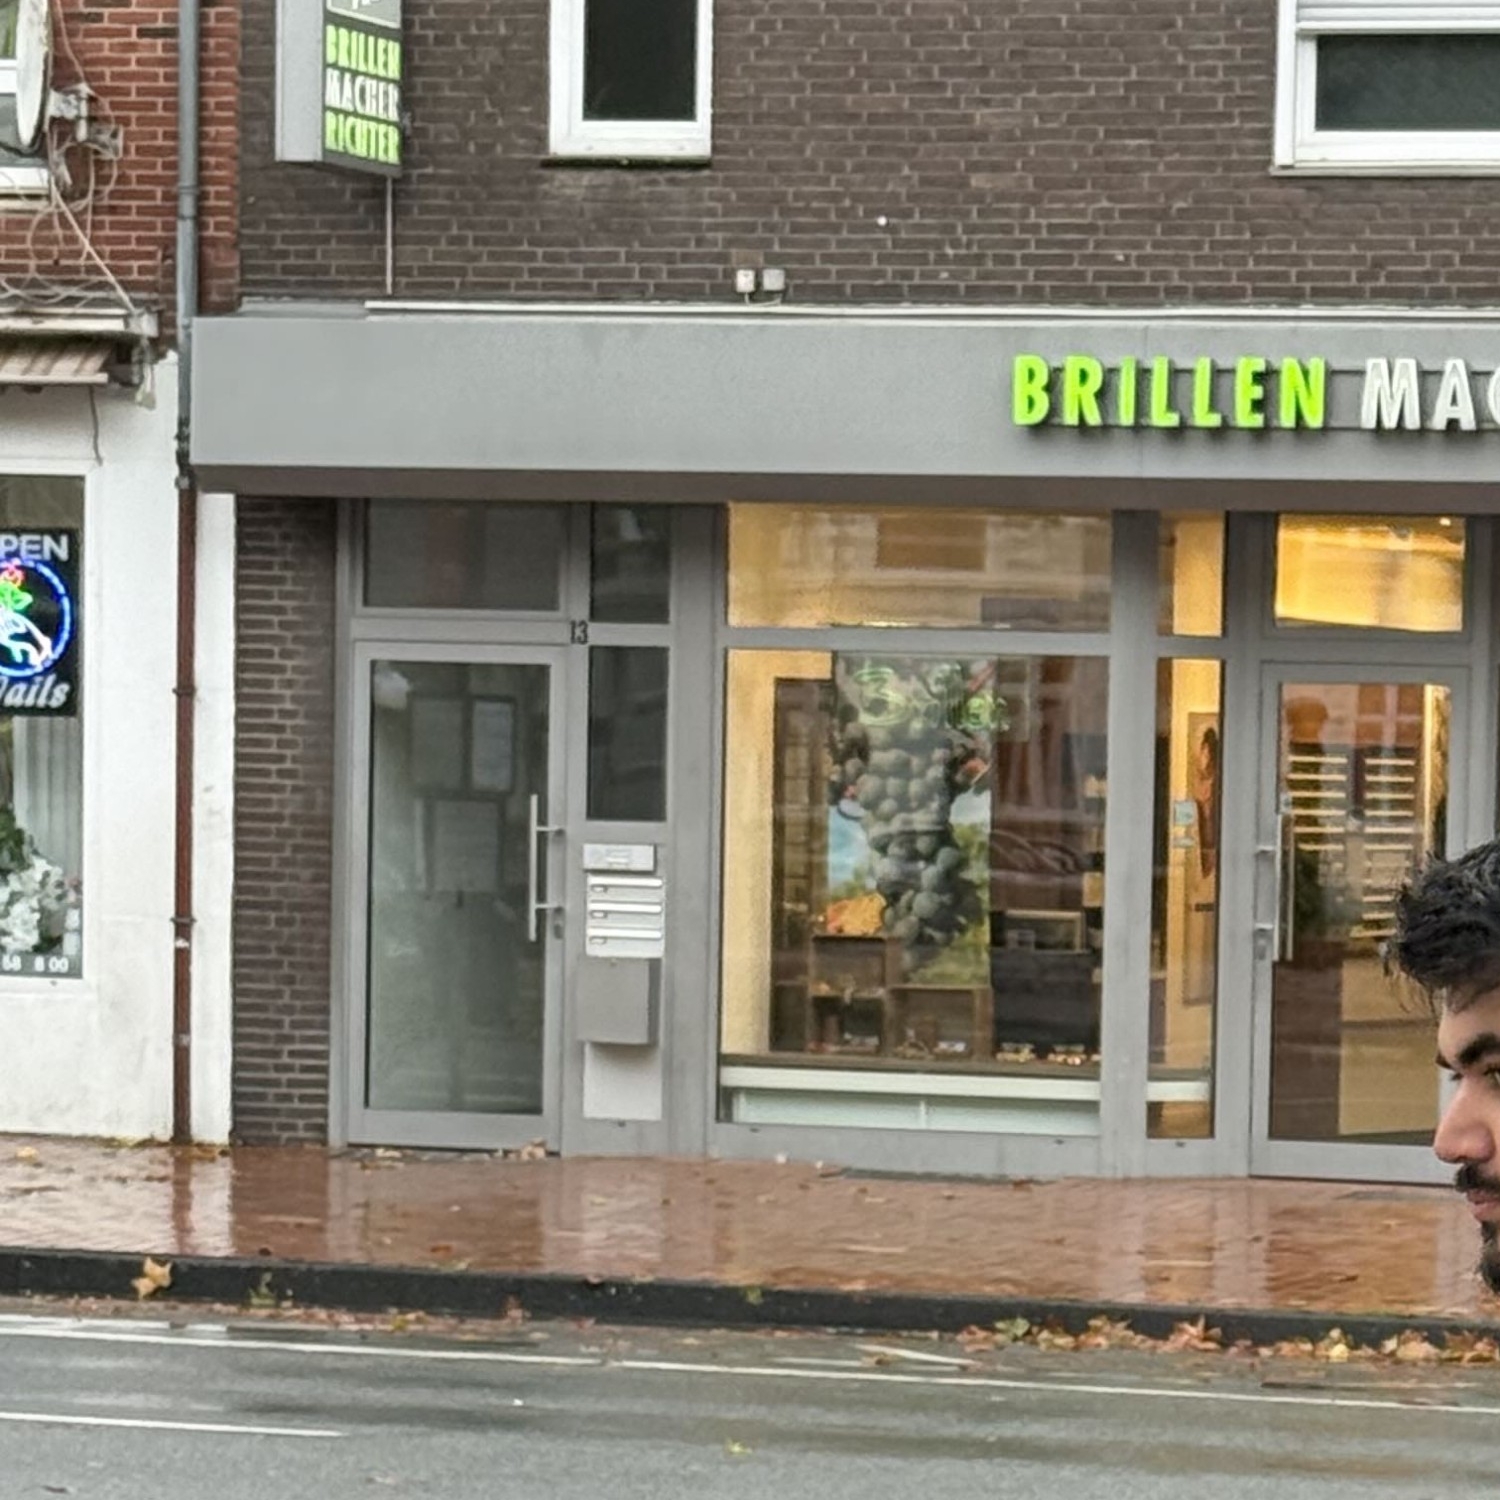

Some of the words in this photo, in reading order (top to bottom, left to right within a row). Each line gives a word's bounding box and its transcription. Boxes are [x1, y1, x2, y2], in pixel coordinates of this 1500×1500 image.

[325, 24, 400, 80] BRILLEN
[1012, 354, 1327, 429] BRILLEN
[570, 619, 588, 645] 13
[0, 675, 70, 709] ails
